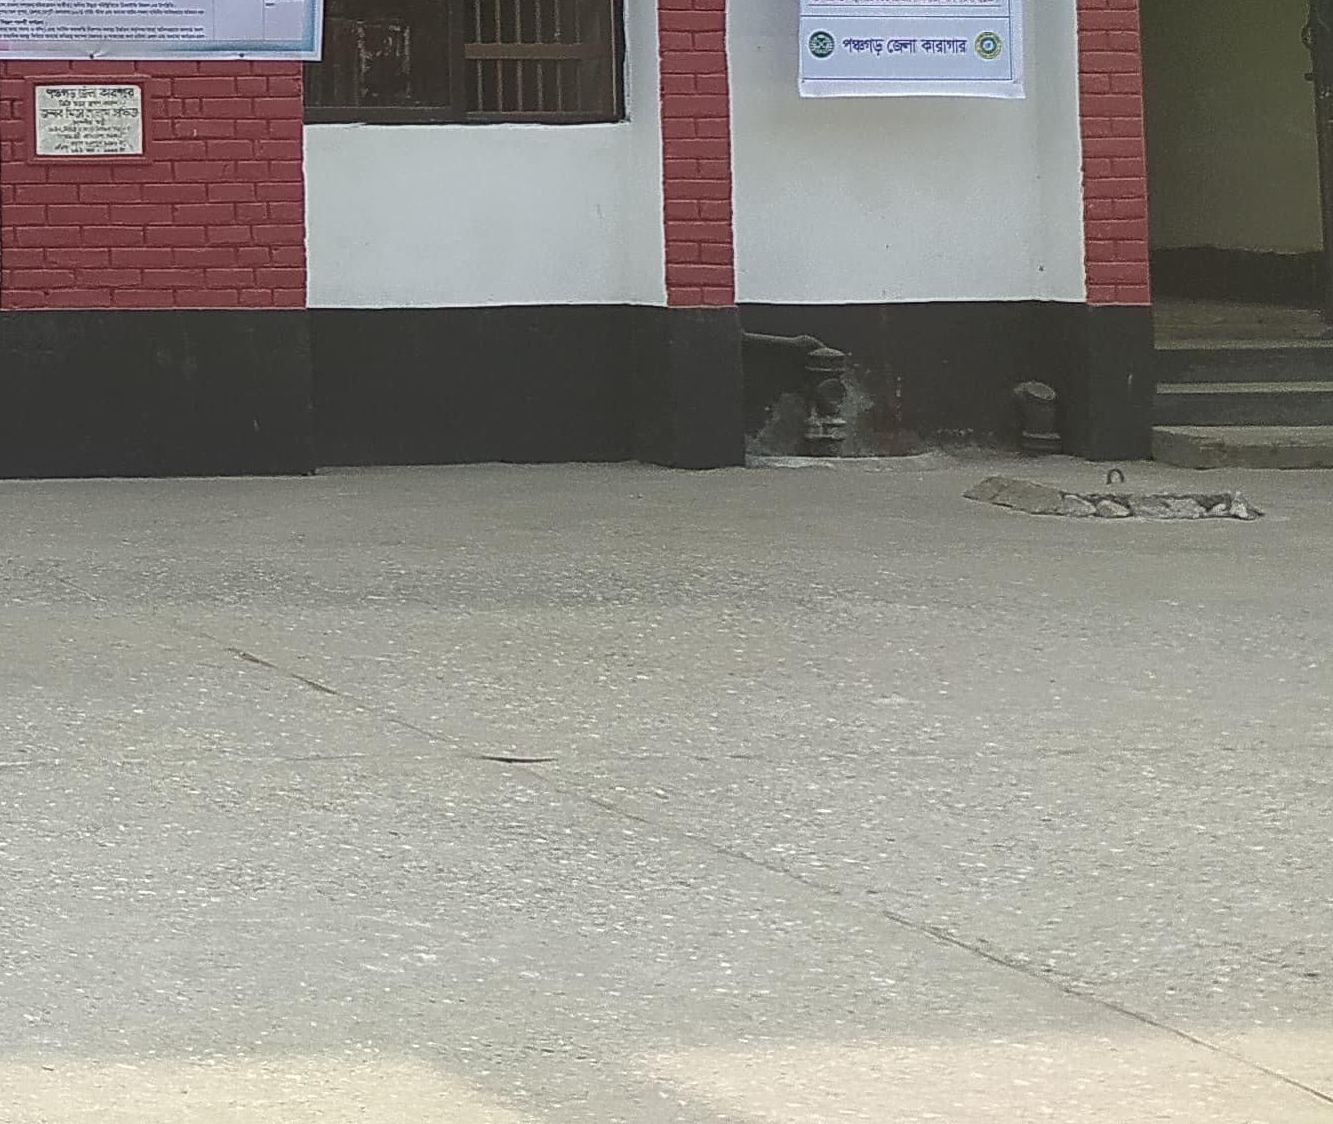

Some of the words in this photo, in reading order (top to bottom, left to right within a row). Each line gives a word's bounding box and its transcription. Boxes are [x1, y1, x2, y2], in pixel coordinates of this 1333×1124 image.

[842, 38, 883, 57] পঞ্চগড়
[886, 38, 917, 54] জেলা
[921, 39, 968, 54] কারাগার
